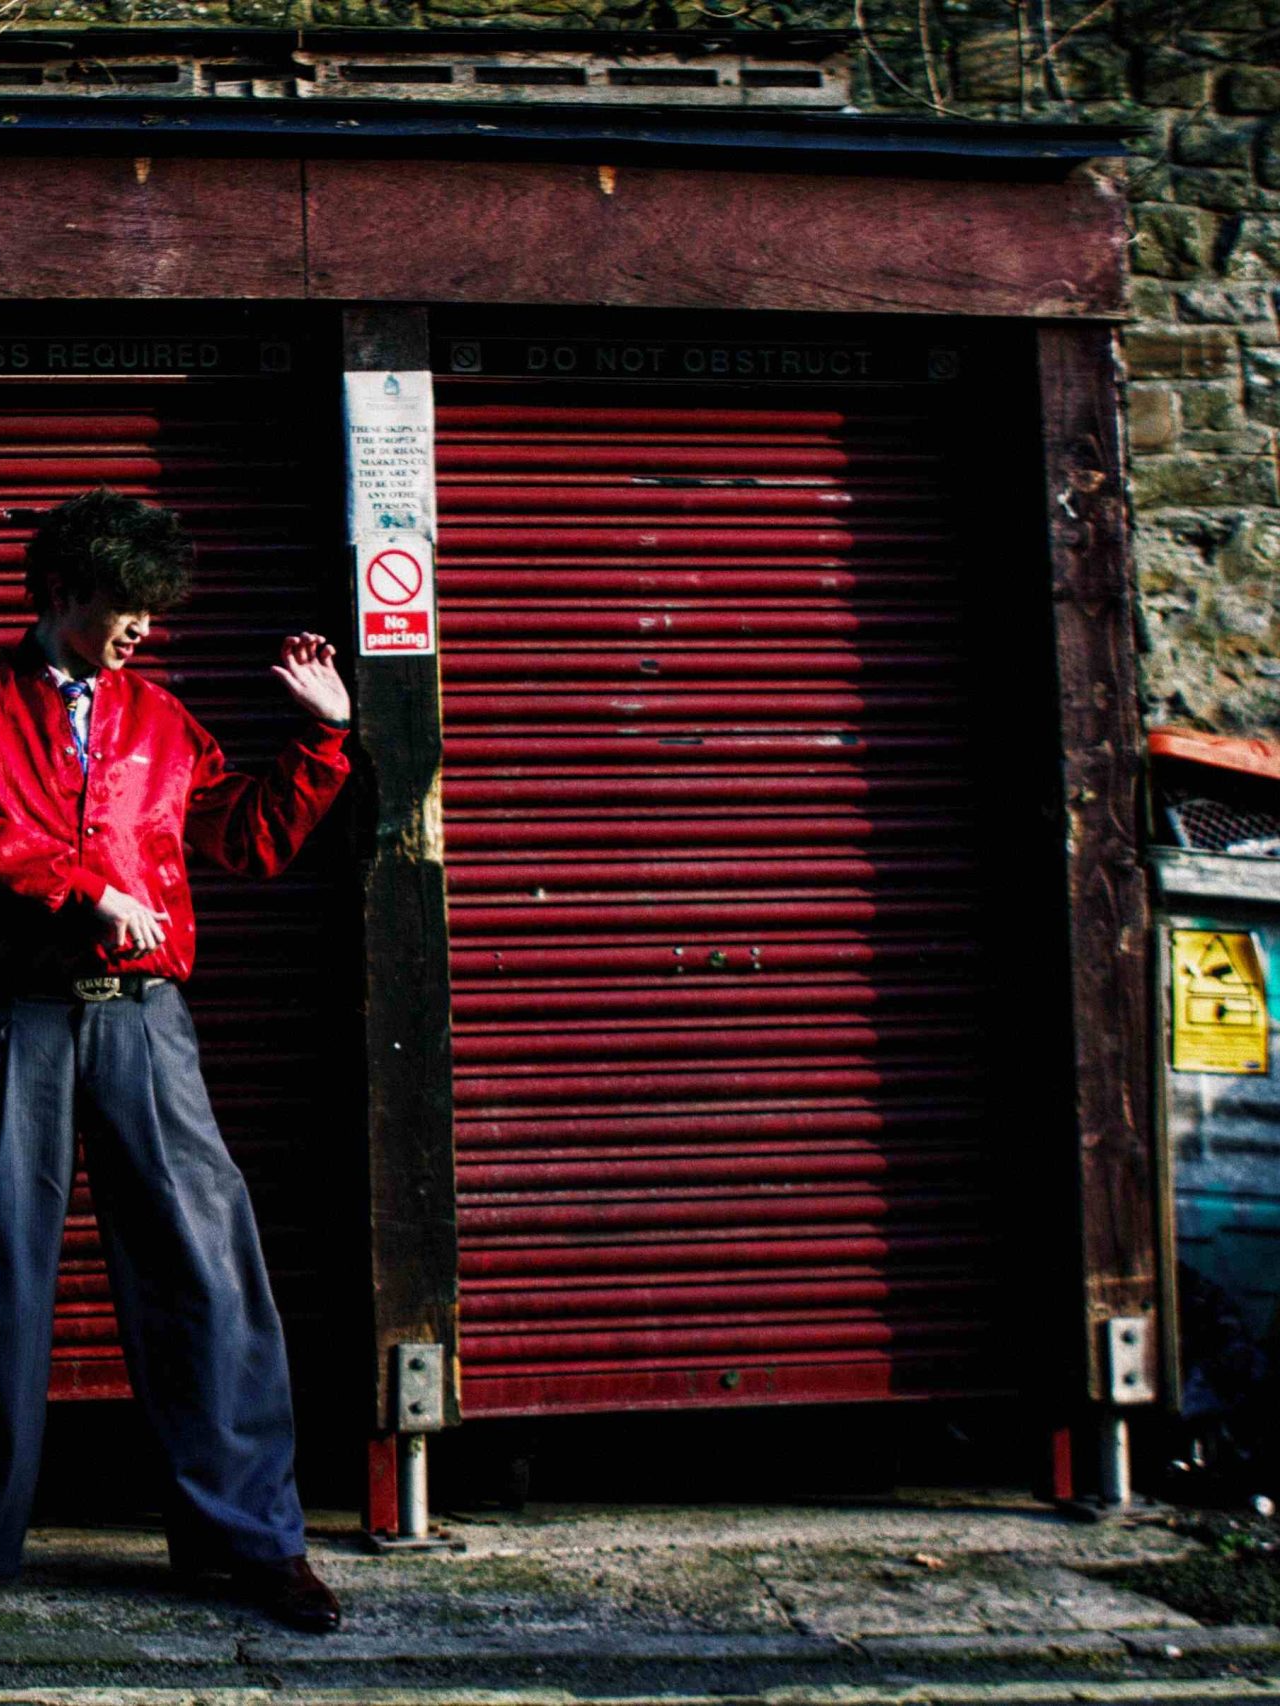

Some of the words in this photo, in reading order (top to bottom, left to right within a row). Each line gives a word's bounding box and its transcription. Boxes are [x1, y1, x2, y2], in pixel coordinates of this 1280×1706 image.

[47, 343, 219, 368] REQUIRED
[526, 347, 575, 371] DO
[594, 348, 666, 373] NOT
[683, 349, 872, 375] OBSTRUCT
[384, 614, 408, 630] No
[367, 630, 426, 649] parking
